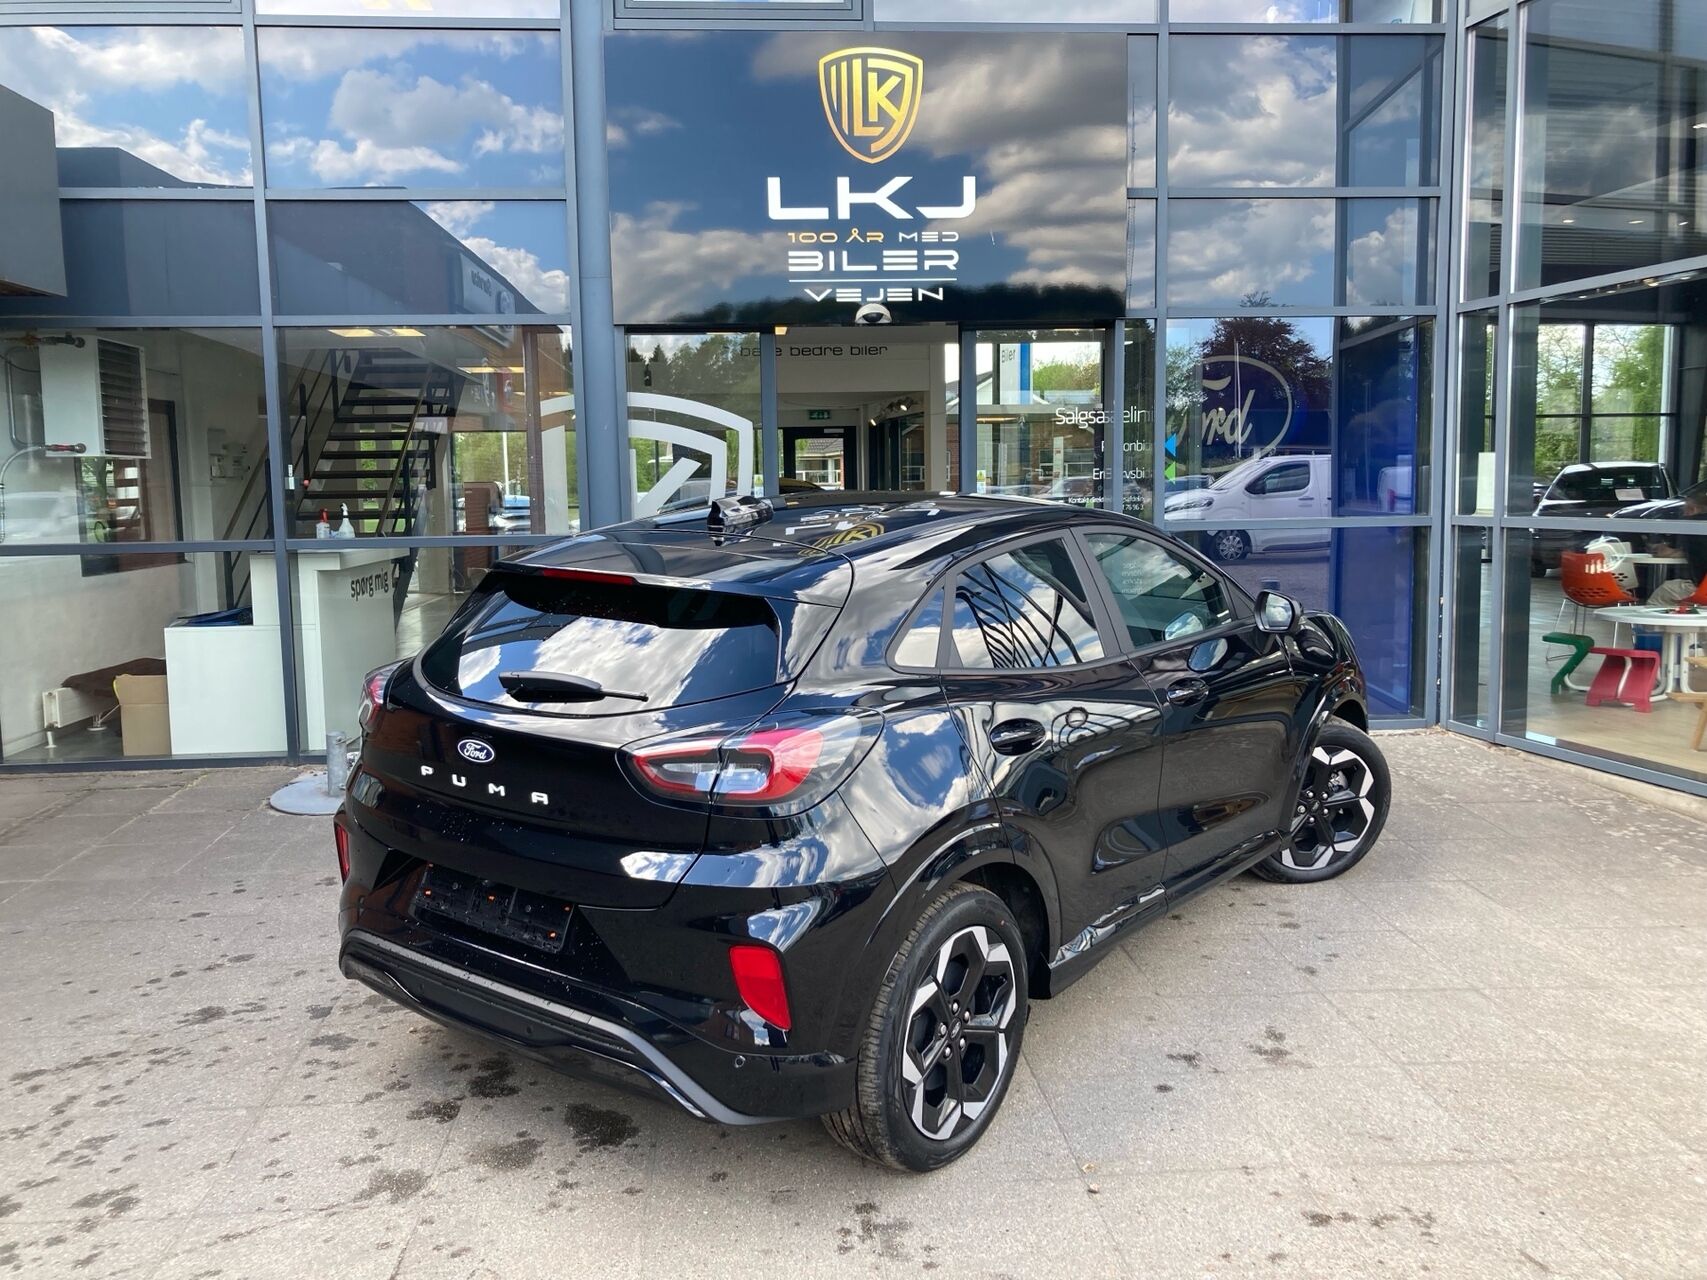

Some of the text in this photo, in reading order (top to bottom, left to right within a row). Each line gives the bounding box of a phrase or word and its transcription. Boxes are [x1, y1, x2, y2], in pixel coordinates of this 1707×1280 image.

[766, 175, 976, 220] LKJ
[787, 227, 960, 244] 100 ÅR MED
[788, 250, 960, 272] BILER
[803, 287, 945, 302] VEJEN
[740, 345, 888, 357] bae bedre biler
[463, 741, 488, 760] Ford
[420, 764, 549, 806] PUMA
